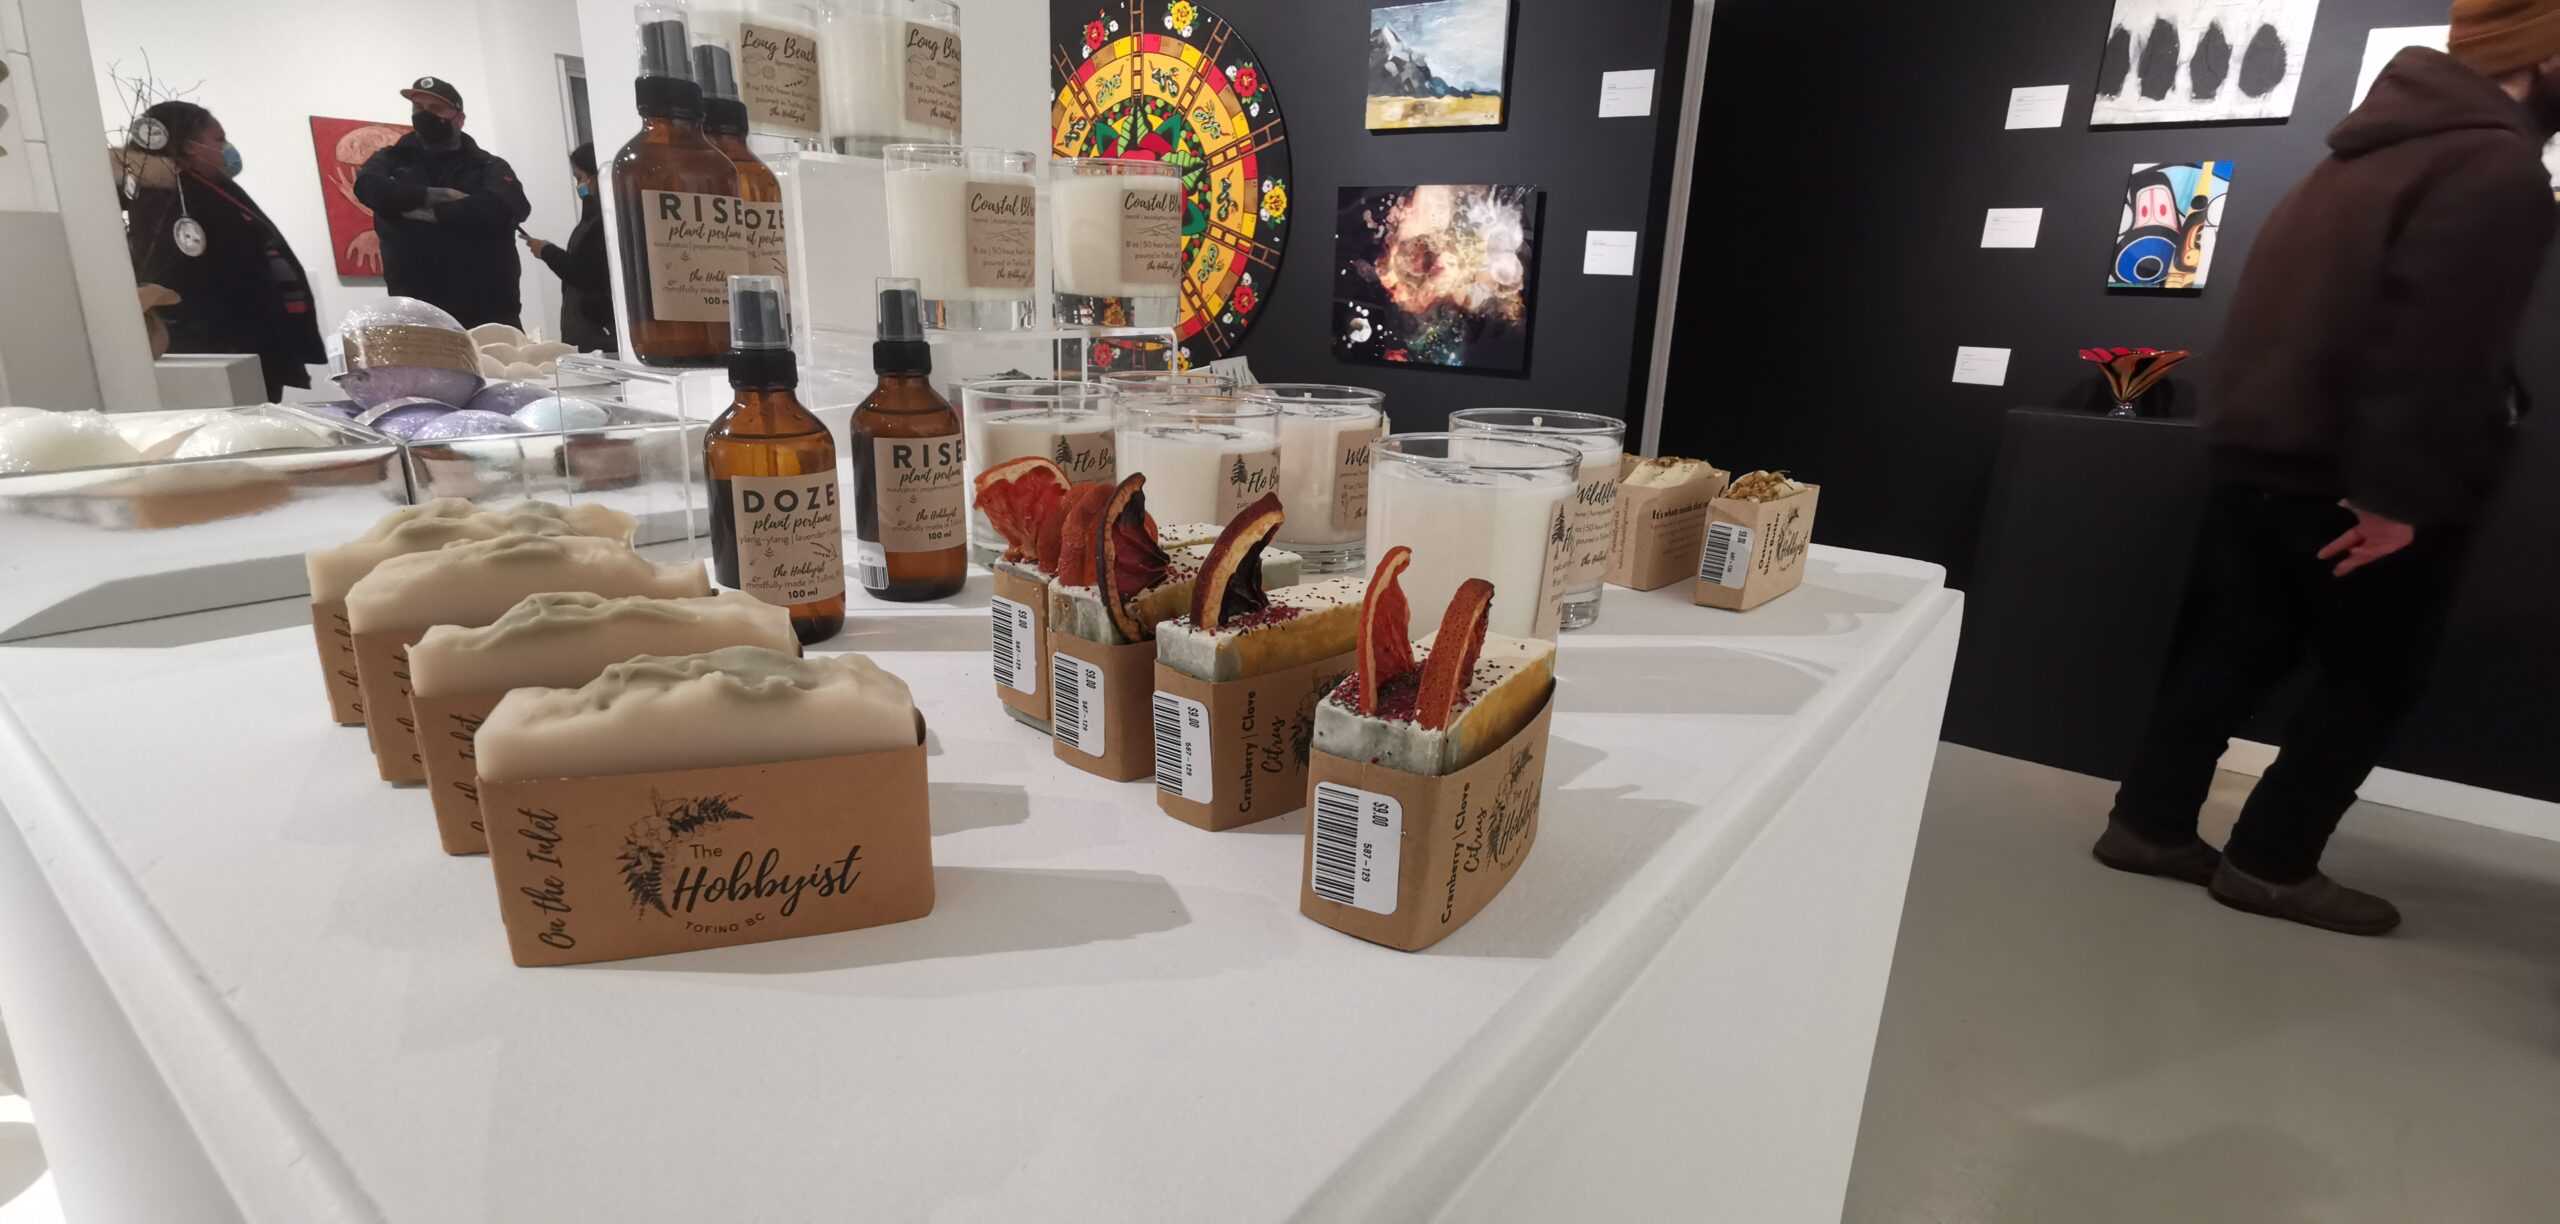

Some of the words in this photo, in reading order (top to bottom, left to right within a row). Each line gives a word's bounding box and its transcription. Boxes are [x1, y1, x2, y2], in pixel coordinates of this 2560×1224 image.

[742, 29, 779, 61] Long
[906, 28, 938, 61] Long
[659, 193, 743, 225] RISE
[971, 192, 1018, 216] Coastal
[1124, 191, 1168, 212] Coastal
[668, 221, 705, 241] plant
[744, 207, 784, 230] OZE
[704, 296, 720, 305] 100
[893, 440, 962, 468] RISE
[1073, 449, 1096, 472] Flo
[899, 467, 932, 489] plant
[1247, 470, 1267, 493] Flo
[742, 483, 835, 513] DOZE
[752, 512, 791, 535] plant
[928, 532, 942, 541] 100
[773, 564, 787, 579] the
[788, 590, 806, 599] 100
[807, 588, 818, 597] ml
[1187, 706, 1200, 729] $9.00
[1241, 691, 1256, 732] Clove
[1260, 715, 1286, 773] Citrus
[1239, 743, 1258, 813] Cranberry
[1372, 801, 1389, 828] $9.00
[518, 807, 563, 867] Inlet
[1463, 807, 1488, 873] Citrus
[690, 844, 723, 860] The
[1440, 842, 1466, 925] Cranberry
[1454, 781, 1471, 831] Clove
[671, 845, 862, 917] Hobbyist
[531, 874, 573, 921] the
[539, 918, 576, 950] On
[684, 920, 740, 935] TOFINO
[745, 912, 766, 927] BC
